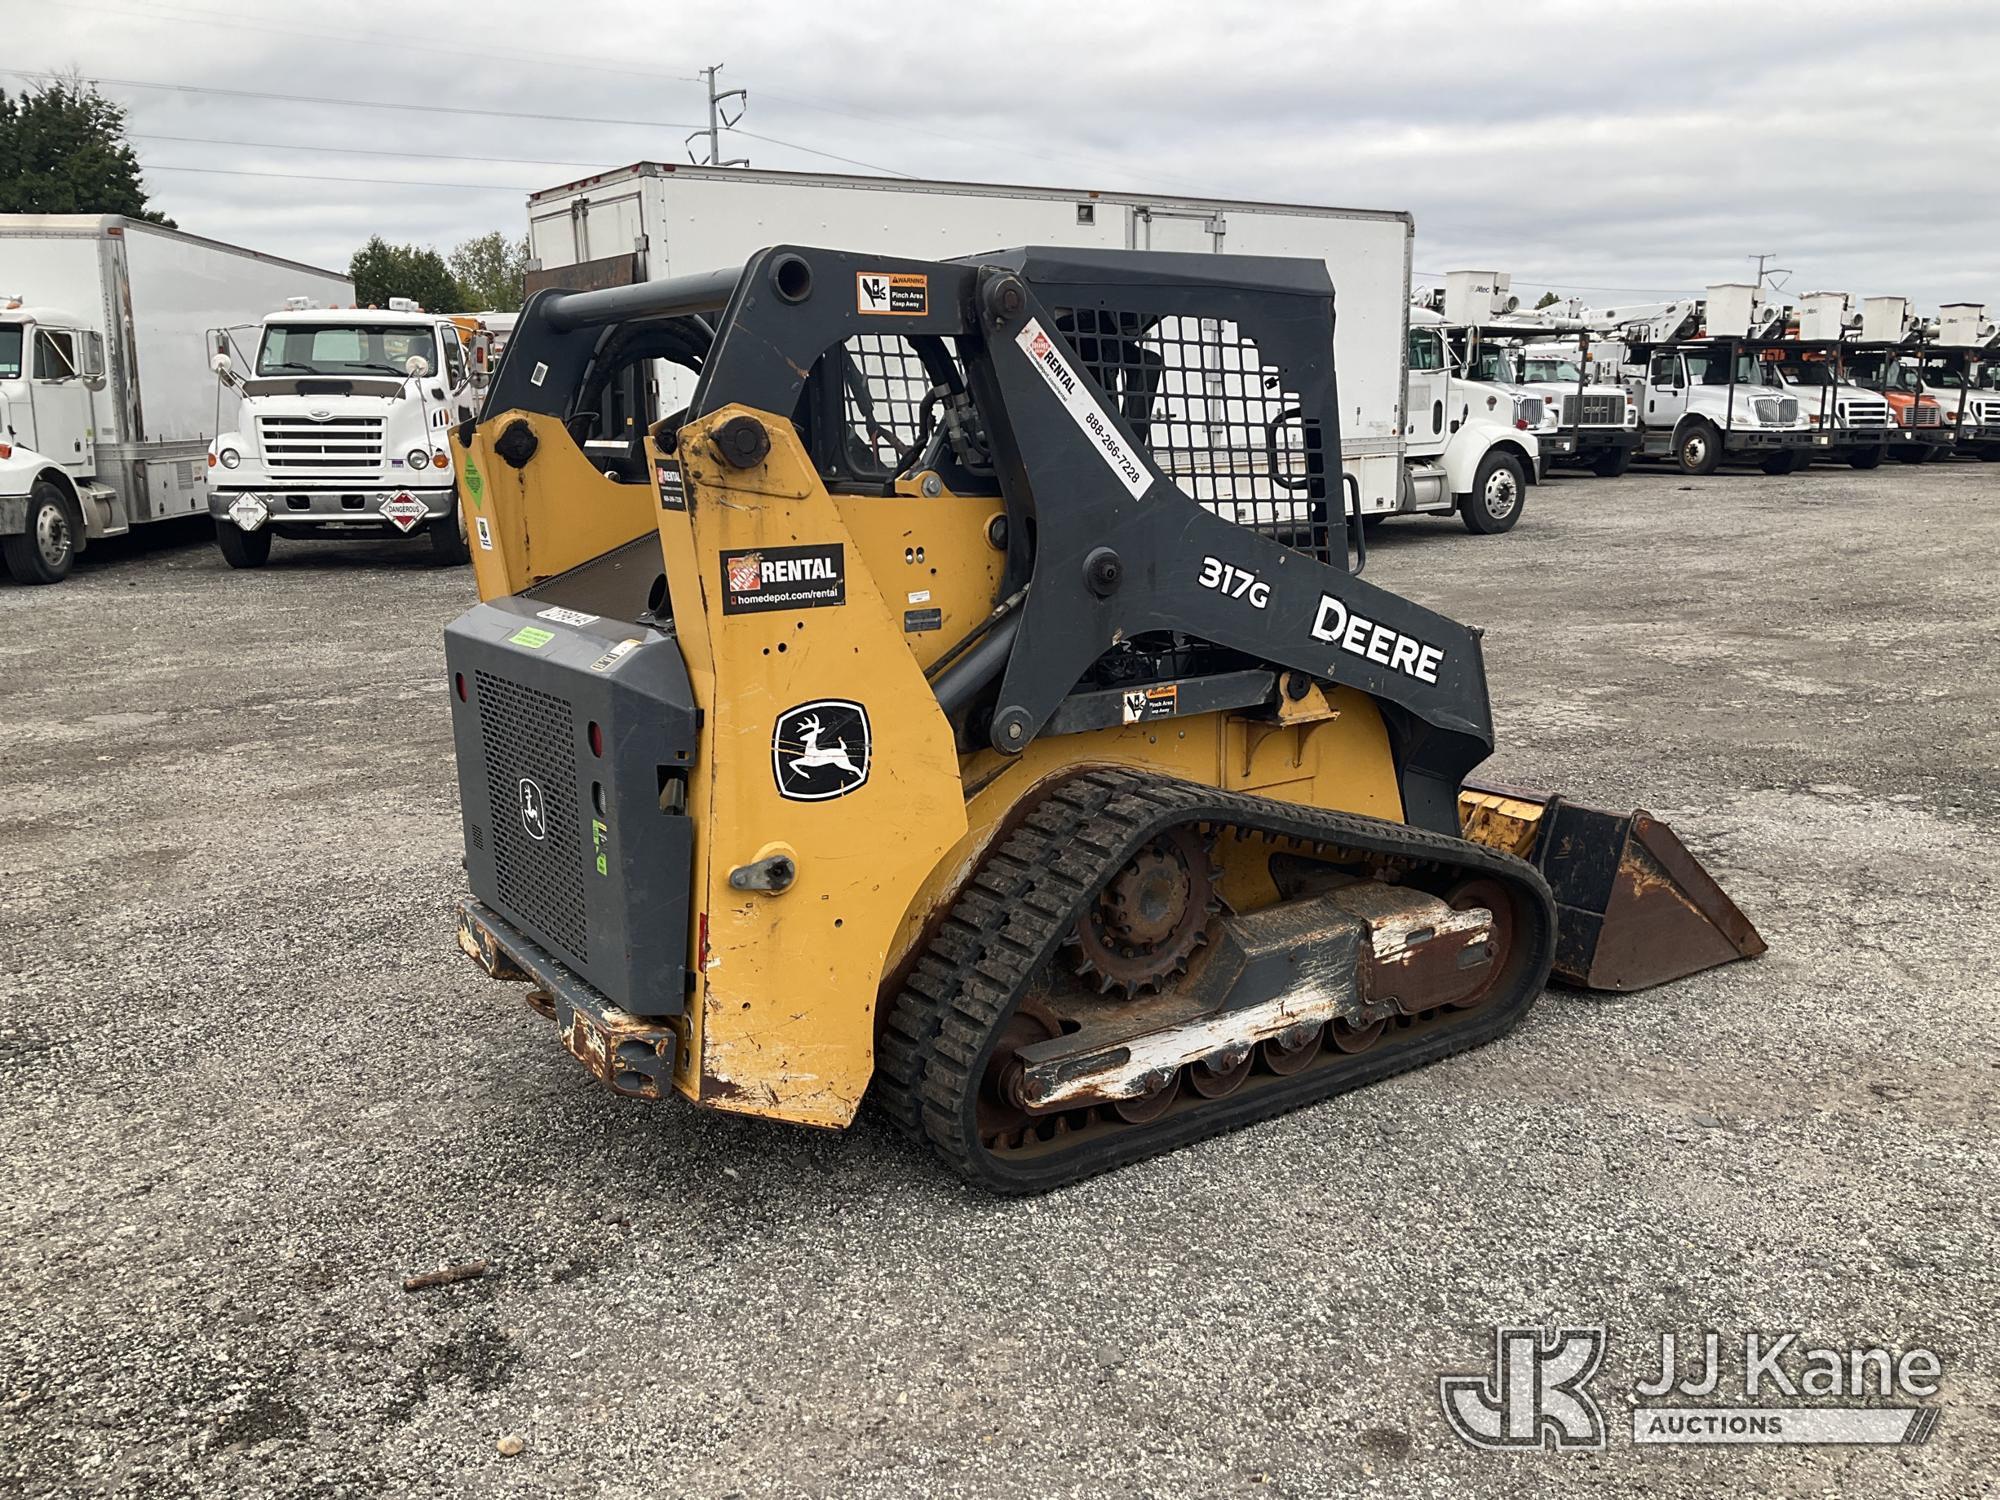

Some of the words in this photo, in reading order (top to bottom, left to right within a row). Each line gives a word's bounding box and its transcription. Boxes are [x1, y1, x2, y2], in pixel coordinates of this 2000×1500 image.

[1043, 350, 1076, 395] RENTAL
[1085, 412, 1140, 484] 888-266-7228
[388, 505, 420, 513] DANGEROUS
[760, 557, 837, 583] RENTAL
[1198, 556, 1271, 609] 317G
[737, 588, 838, 605] homedepot.com/rental
[1311, 594, 1444, 684] DEERE
